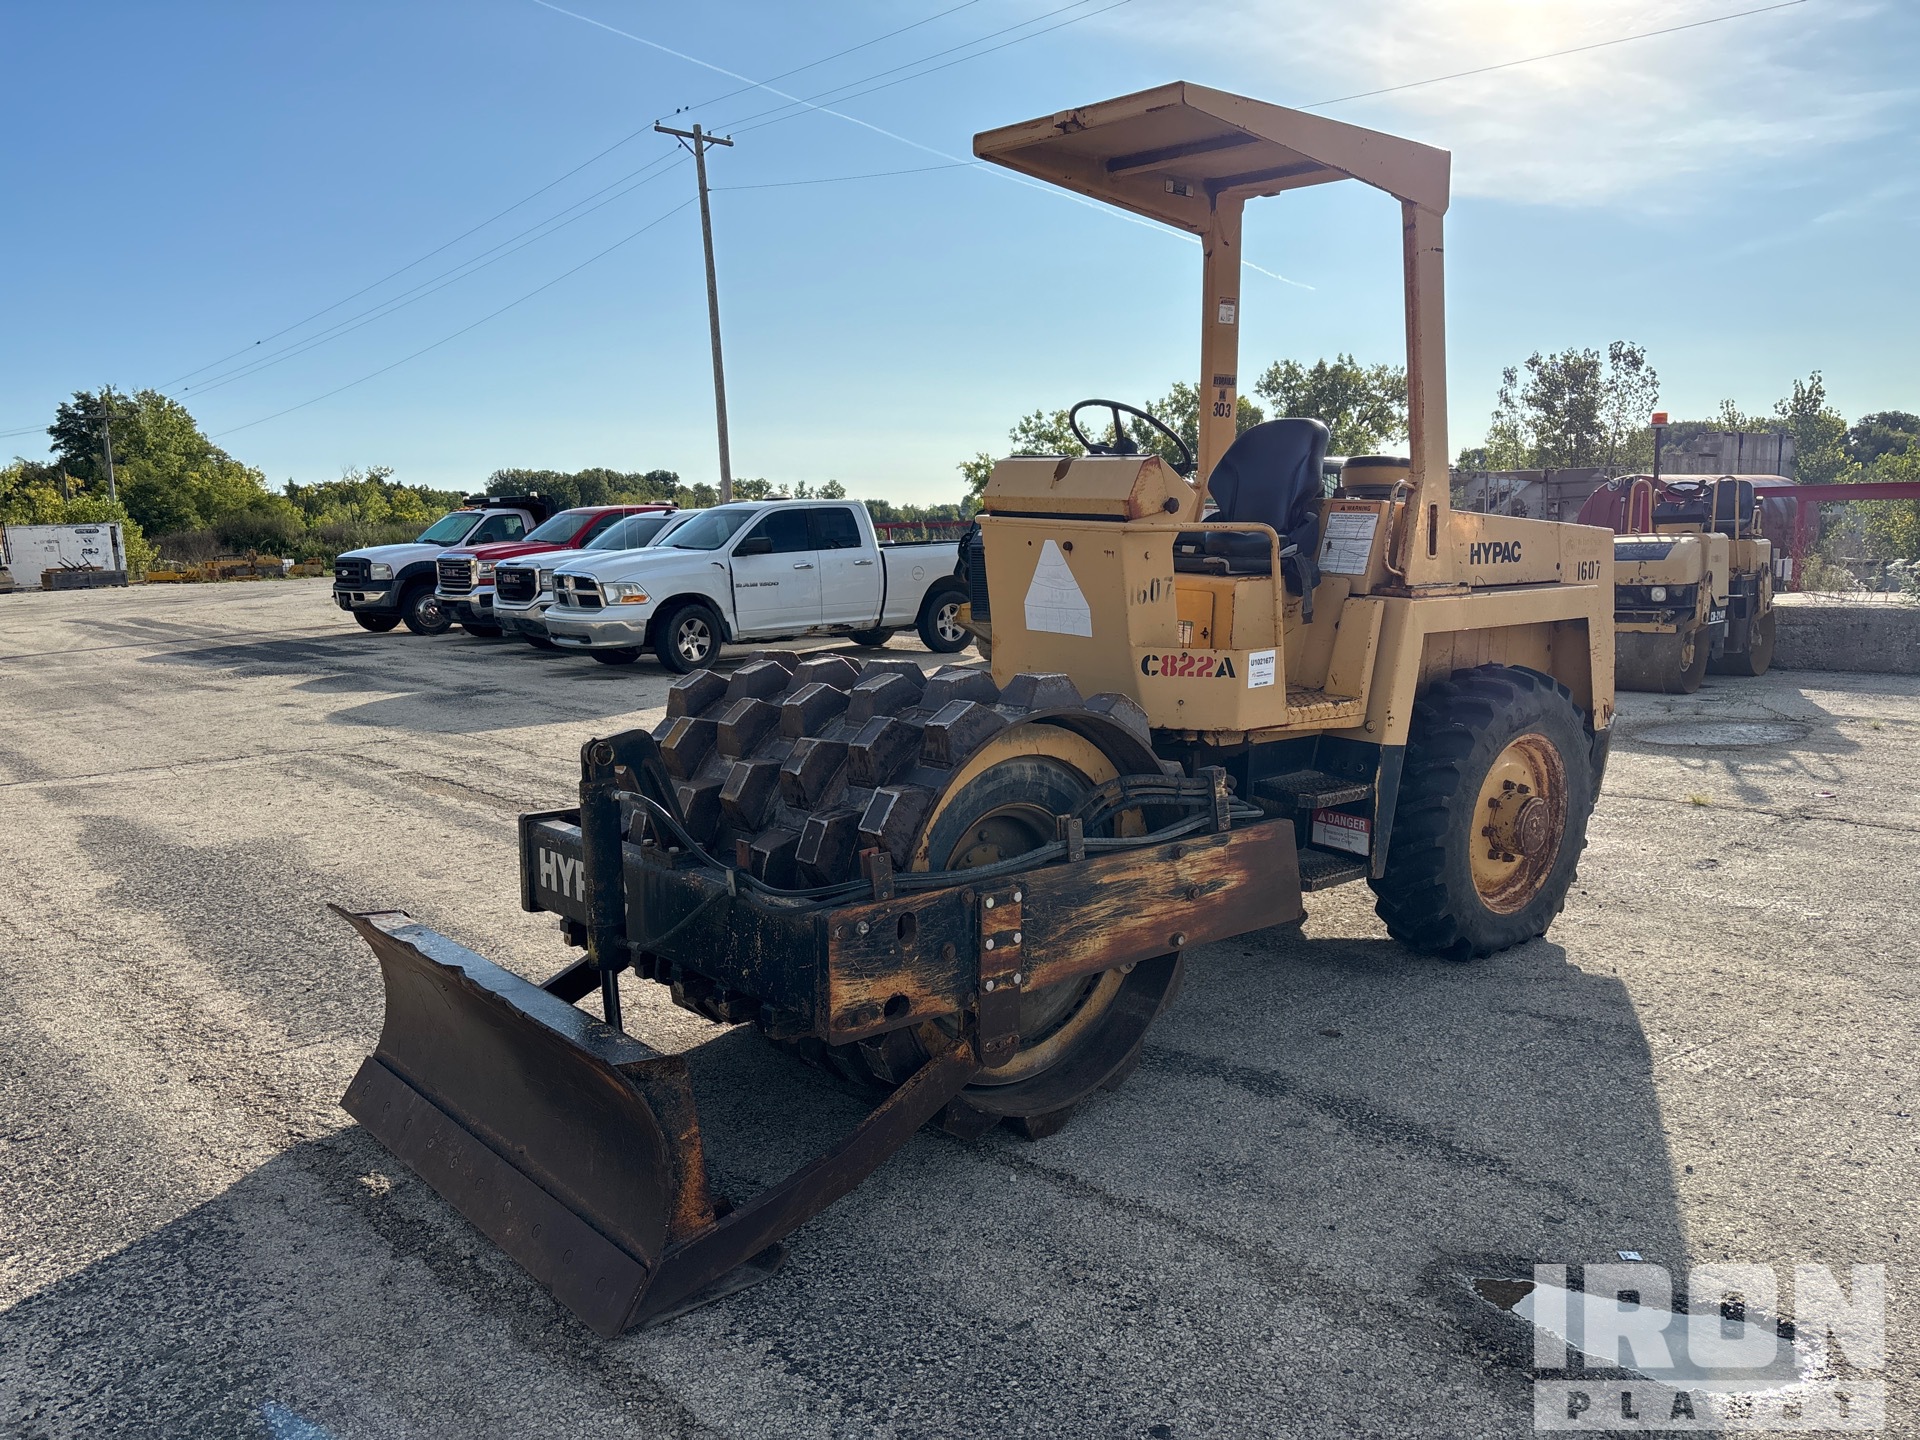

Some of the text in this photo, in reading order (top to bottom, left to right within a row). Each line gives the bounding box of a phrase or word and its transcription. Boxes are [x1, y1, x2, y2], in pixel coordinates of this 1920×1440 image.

[1213, 401, 1231, 418] 303
[1470, 541, 1522, 565] HYPAC
[1577, 560, 1601, 581] 1607
[1130, 576, 1174, 607] 1607
[1140, 654, 1236, 678] C822A
[1327, 813, 1366, 831] DANGER
